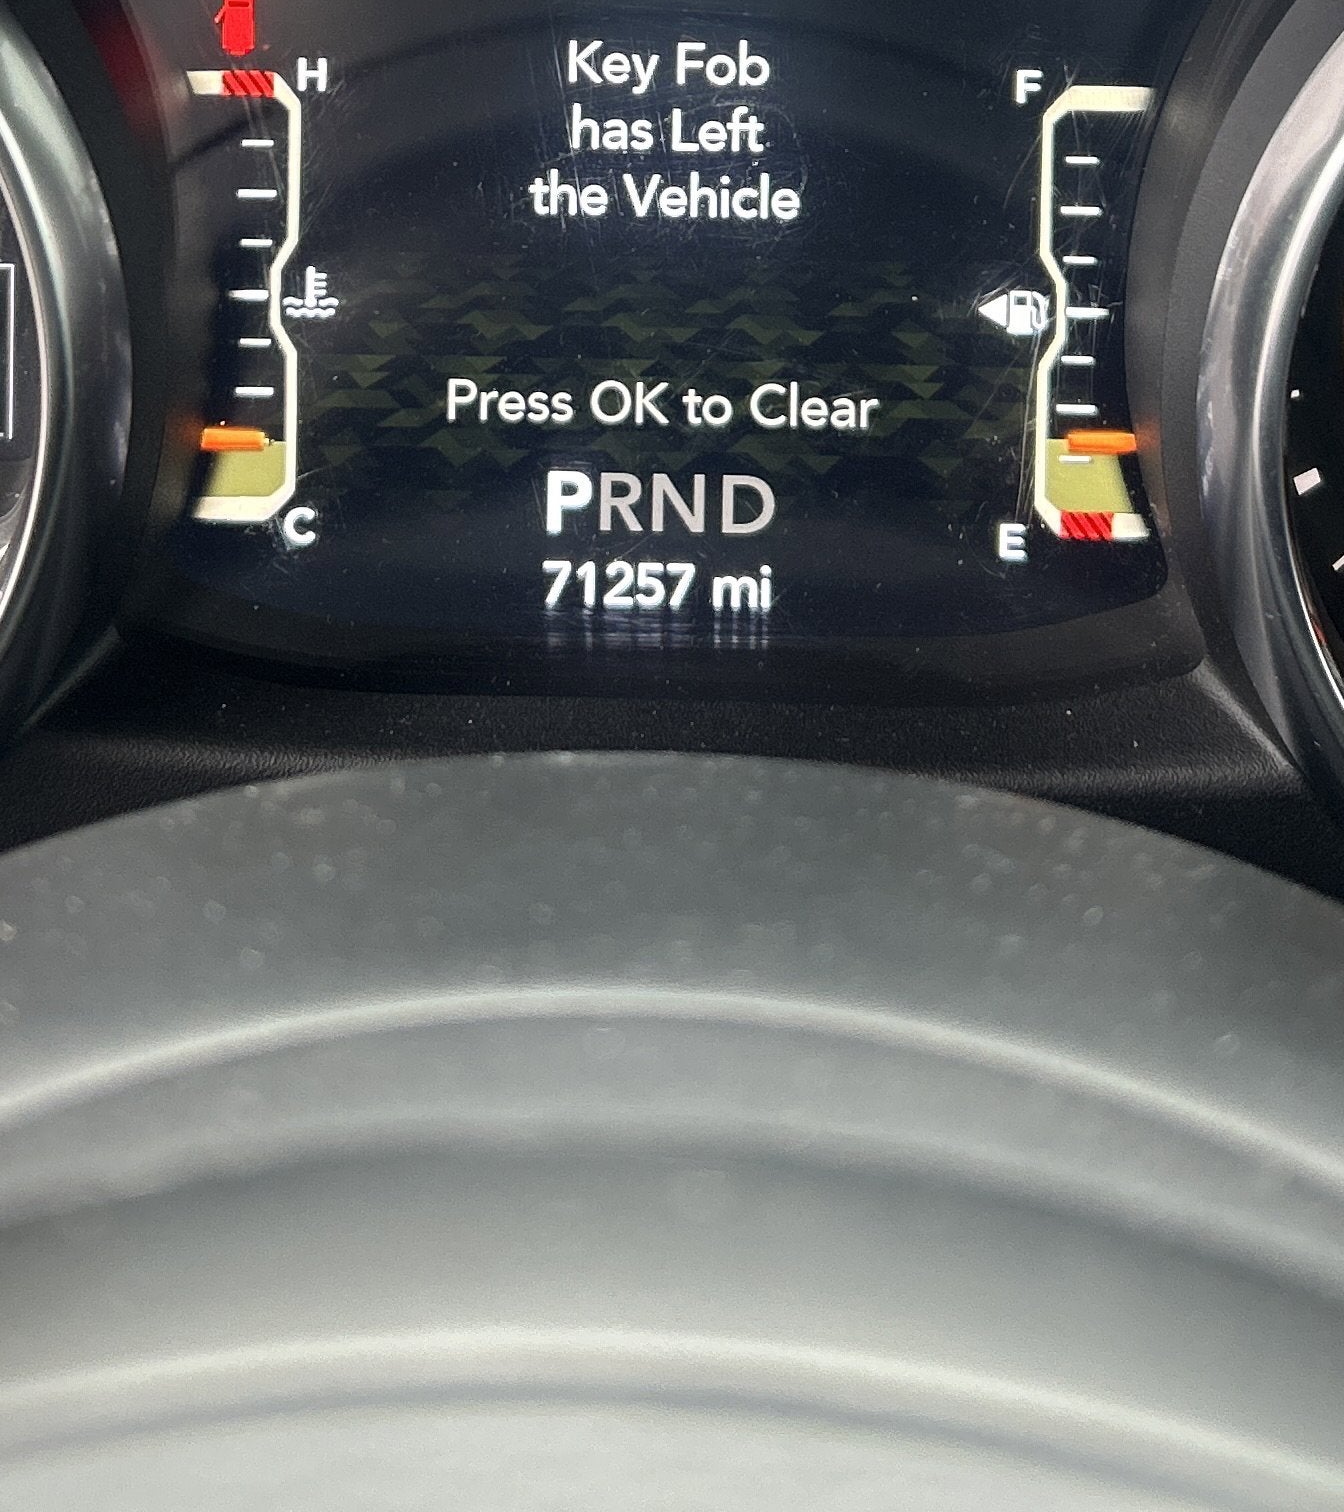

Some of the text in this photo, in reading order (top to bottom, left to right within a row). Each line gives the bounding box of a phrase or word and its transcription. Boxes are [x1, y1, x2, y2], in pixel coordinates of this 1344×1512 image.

[295, 57, 328, 93] H
[568, 39, 770, 95] Key Fob
[1015, 69, 1044, 105] F
[568, 102, 765, 153] has Left
[527, 168, 801, 221] the Vehicle
[447, 378, 880, 430] Press OK to Clear
[283, 506, 317, 547] C
[998, 522, 1028, 562] E
[542, 558, 772, 615] 71257 mi
